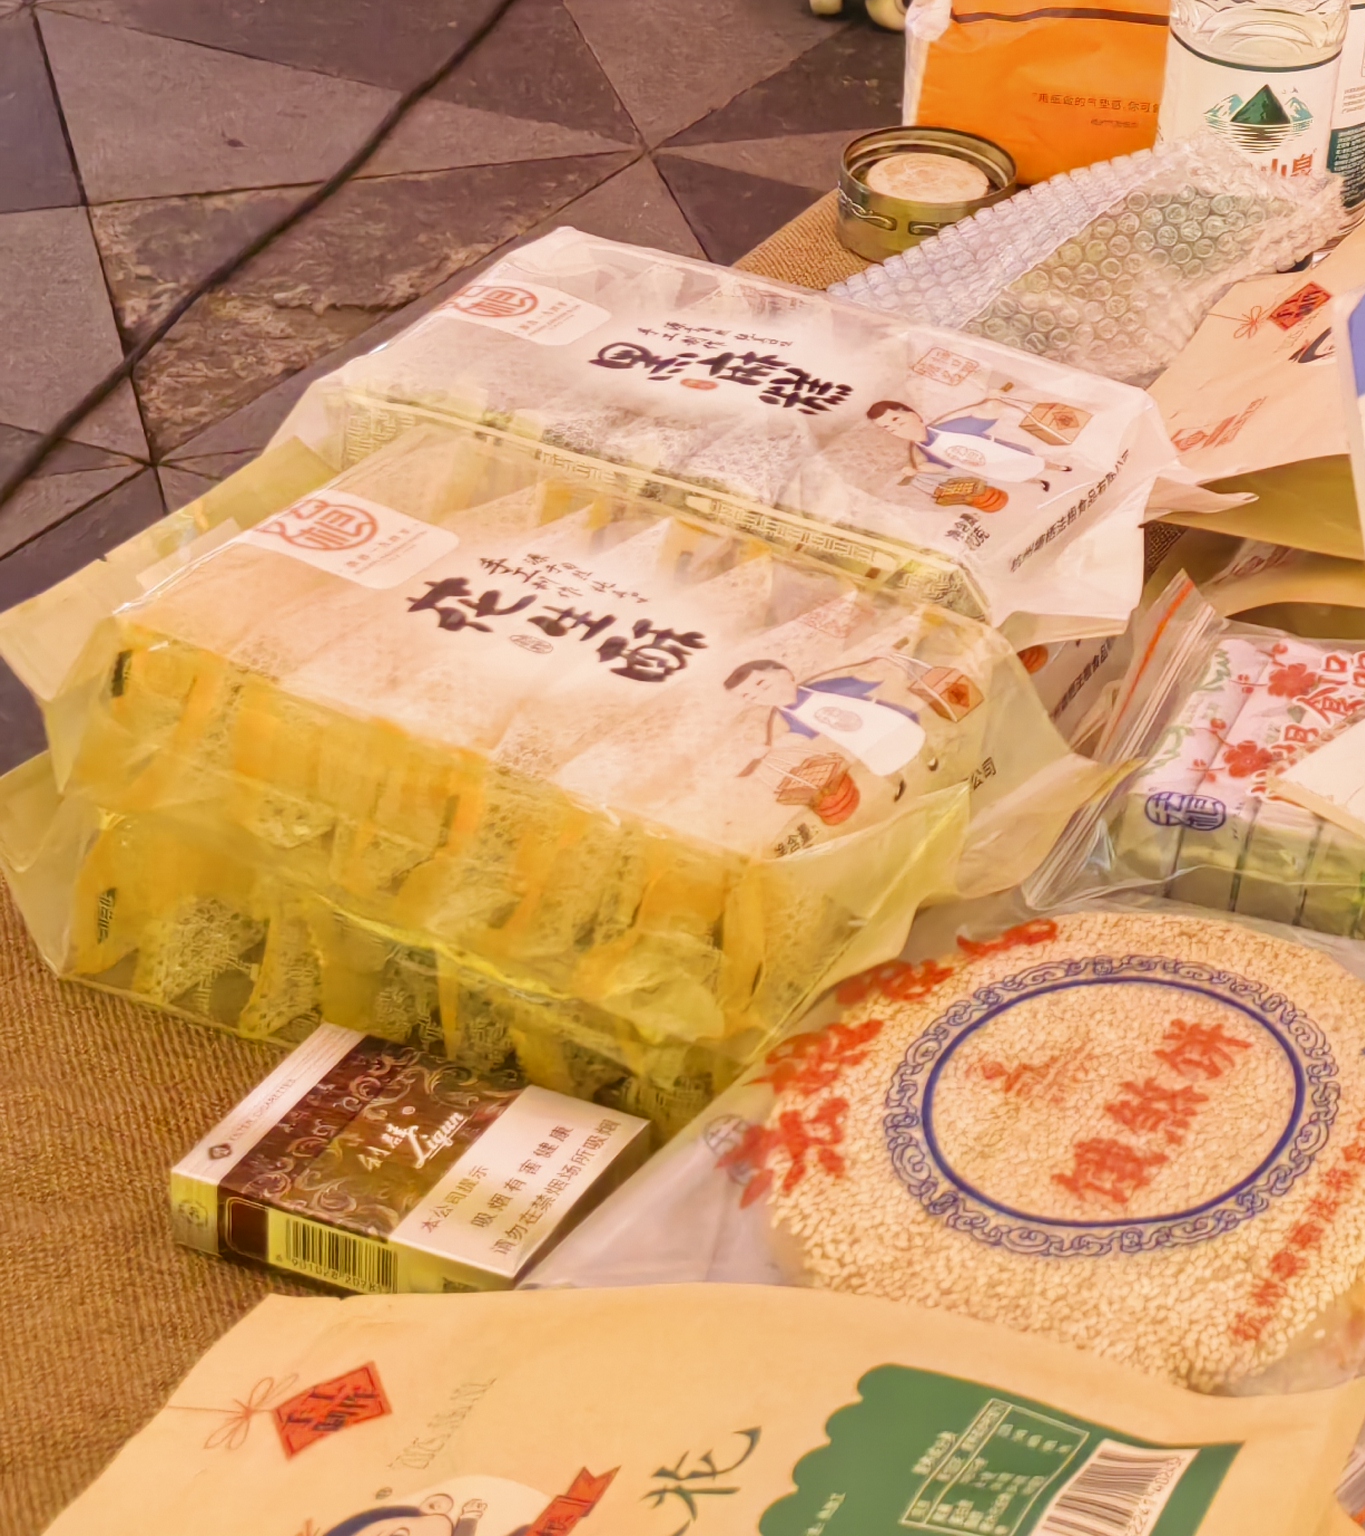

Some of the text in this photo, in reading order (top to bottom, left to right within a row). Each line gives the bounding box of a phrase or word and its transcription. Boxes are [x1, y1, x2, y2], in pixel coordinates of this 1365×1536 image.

[420, 1163, 492, 1235] 本公司提示
[469, 1123, 574, 1230] 吸烟有害健康
[489, 1117, 624, 1257] 请勿在禁烟场所吸烟
